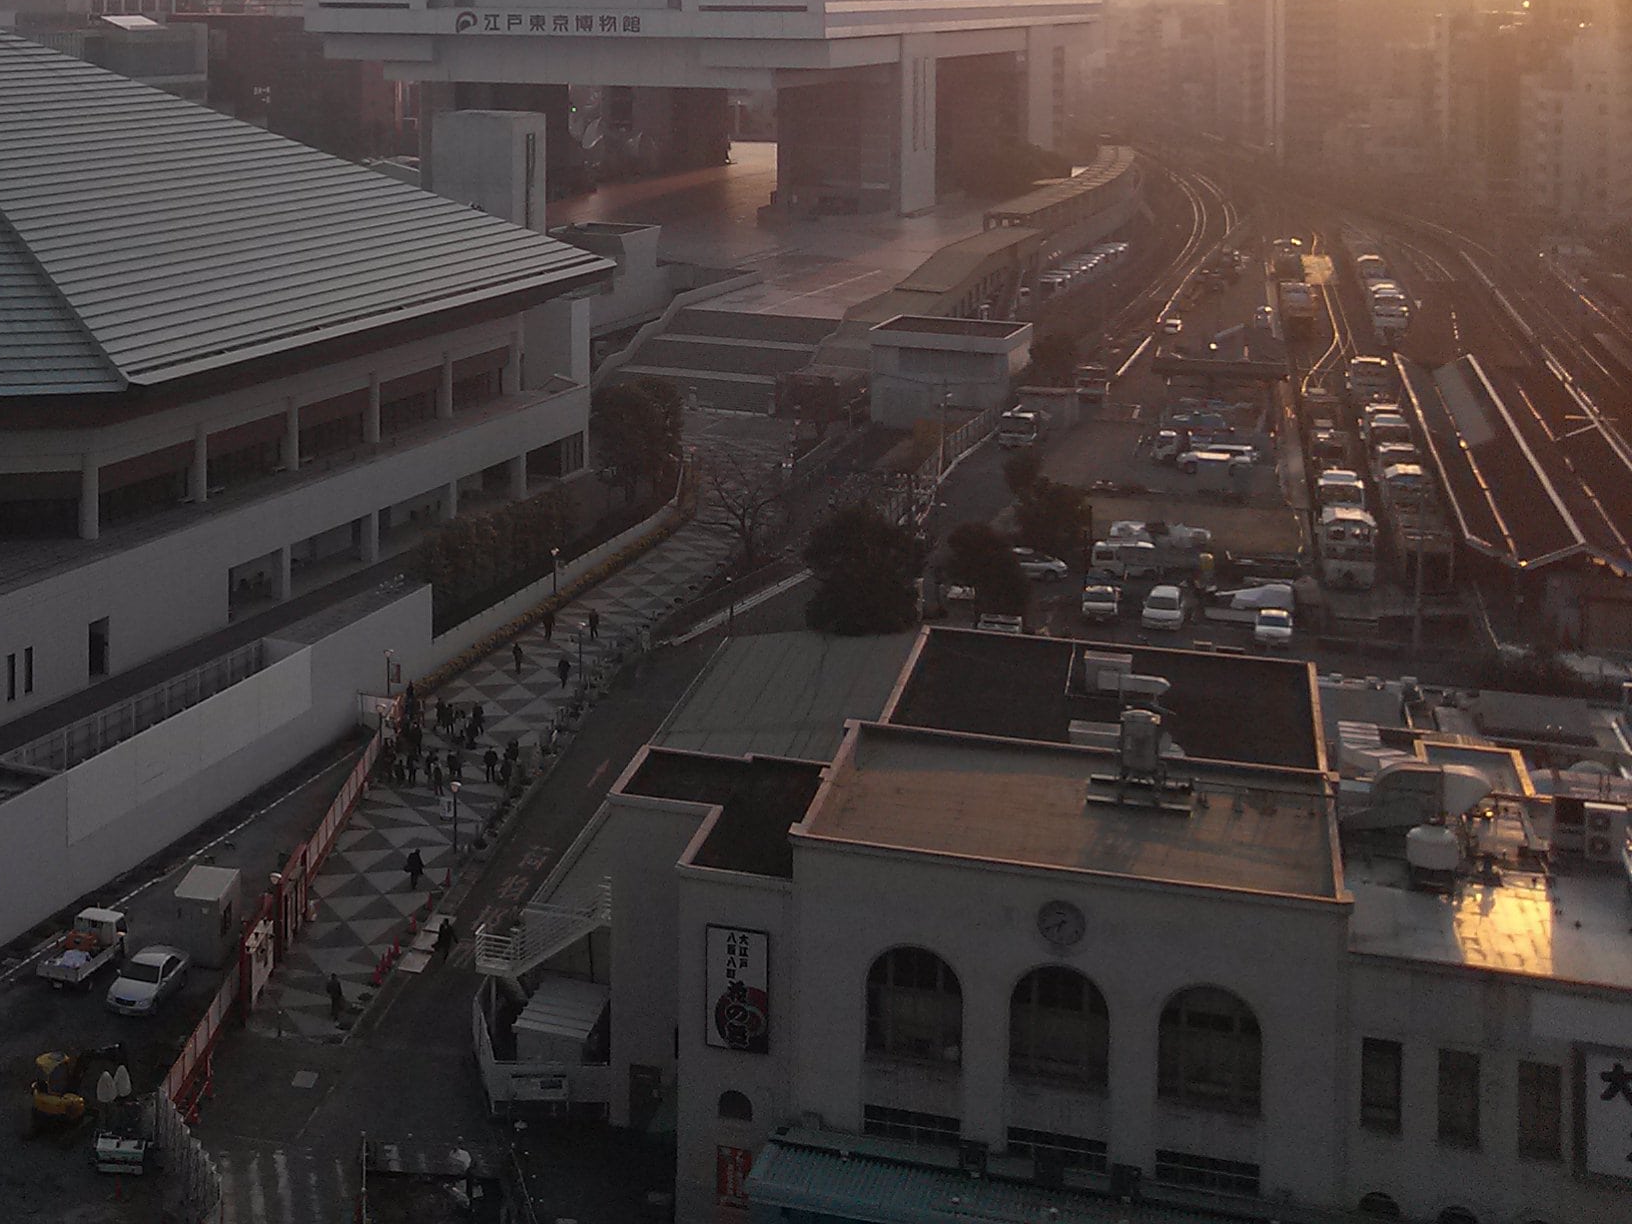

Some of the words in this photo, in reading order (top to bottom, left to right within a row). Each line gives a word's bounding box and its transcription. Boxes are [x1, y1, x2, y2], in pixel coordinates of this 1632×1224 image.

[484, 14, 641, 33] 江戸東京博物館
[738, 933, 749, 969] 大江戸
